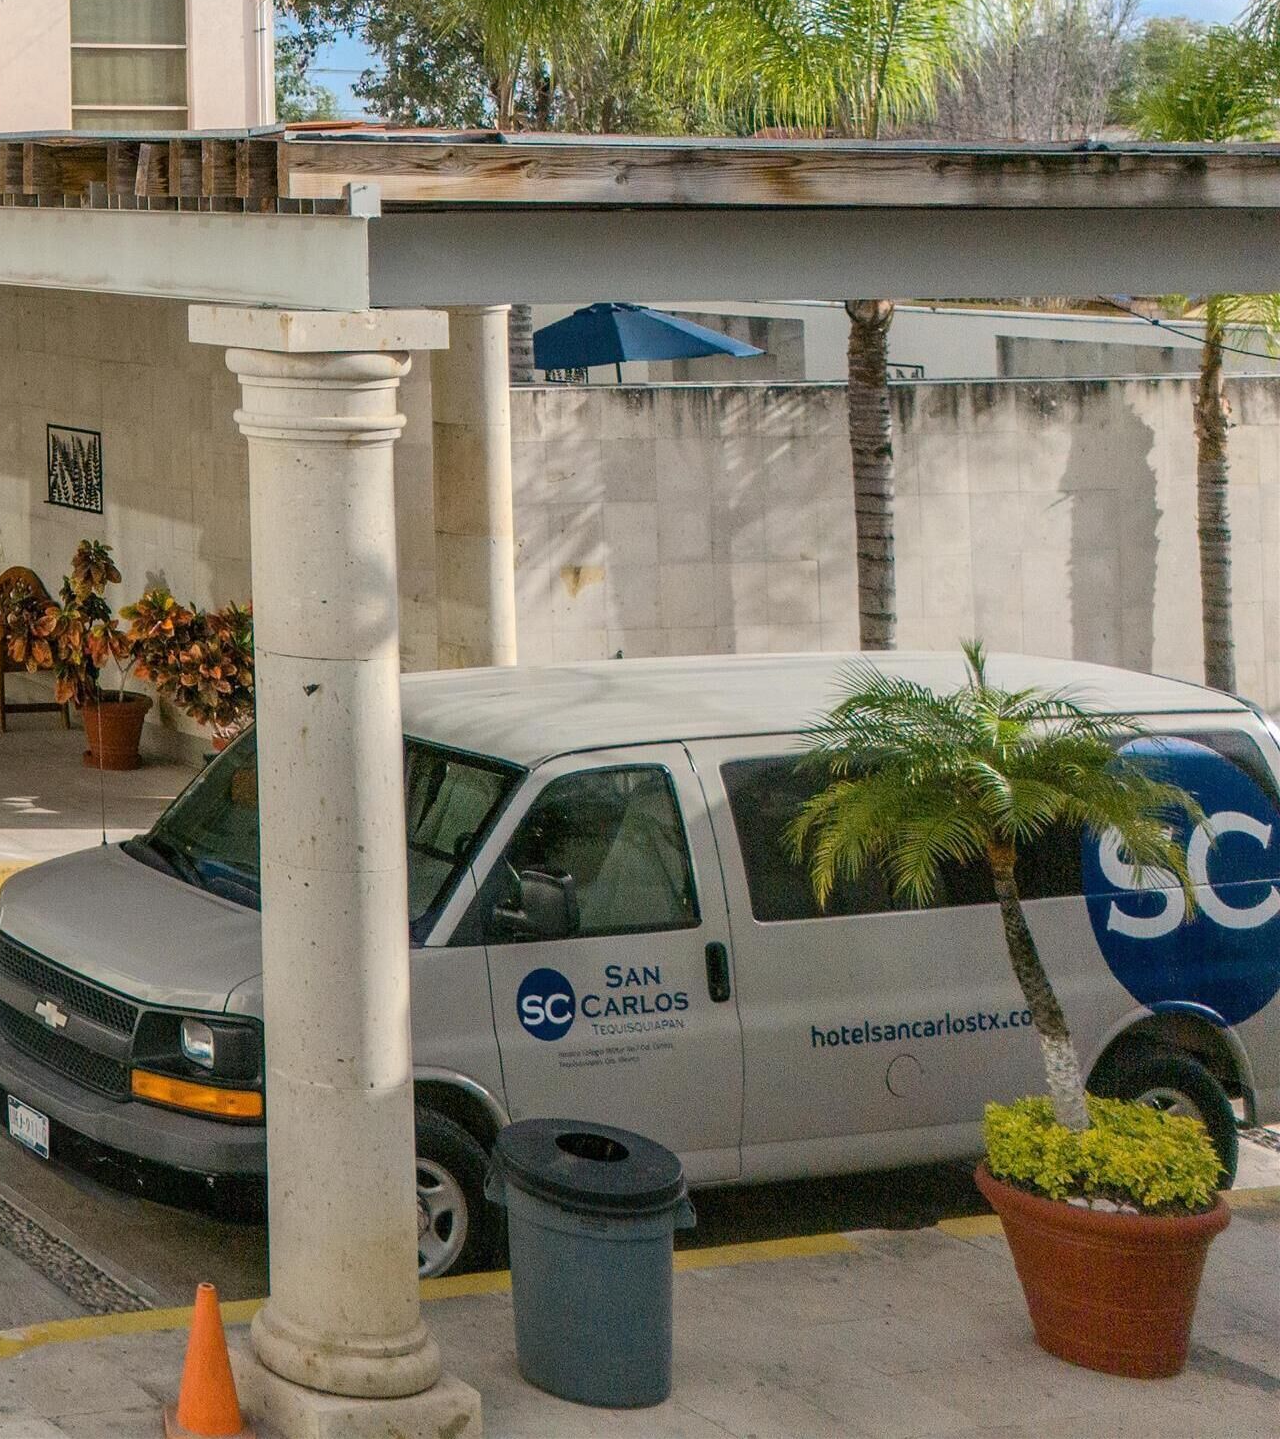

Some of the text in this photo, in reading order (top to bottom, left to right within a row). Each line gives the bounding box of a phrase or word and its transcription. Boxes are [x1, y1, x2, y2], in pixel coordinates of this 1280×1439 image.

[1099, 811, 1280, 939] SC
[604, 964, 662, 989] SAN
[521, 993, 573, 1026] SC
[580, 991, 689, 1018] CARLOS
[811, 1009, 1034, 1048] hotelsancarlostx.co
